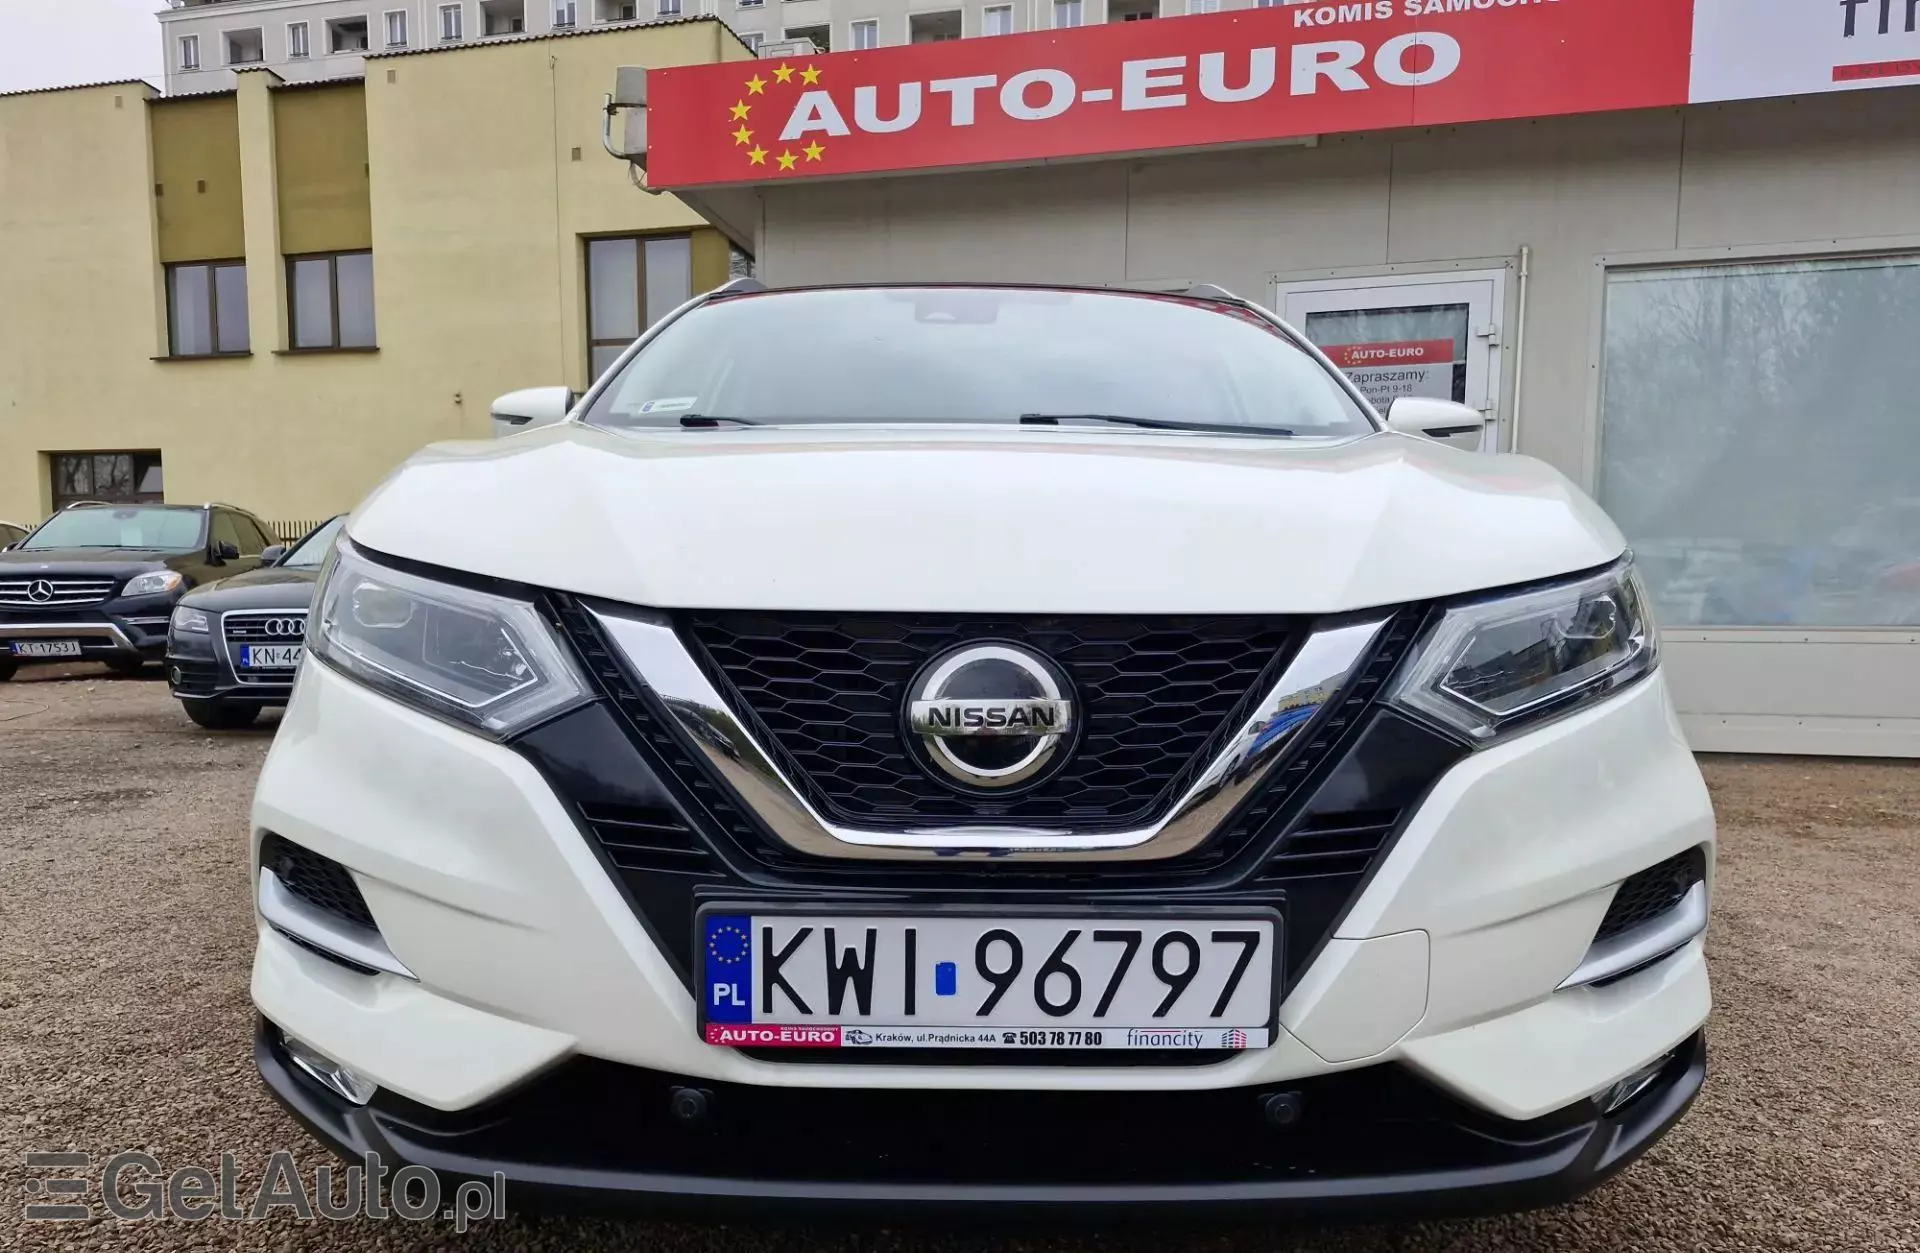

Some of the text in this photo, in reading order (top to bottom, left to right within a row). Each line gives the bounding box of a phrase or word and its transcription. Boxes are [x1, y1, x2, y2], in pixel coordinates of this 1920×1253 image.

[1293, 0, 1393, 27] KOMIS
[778, 30, 1462, 142] AUTO-EURO
[1351, 347, 1424, 360] AUTO-EURO
[1393, 384, 1413, 393] 9-18
[252, 648, 276, 665] KN
[929, 707, 1055, 727] NISSAN
[762, 926, 1262, 1018] KWI 96797
[713, 983, 746, 1007] PL
[719, 1029, 836, 1042] AUTO-EURO
[875, 1033, 914, 1043] Kraków,
[978, 1034, 996, 1042] 44A
[1019, 1031, 1102, 1046] 503 78 77 80
[1127, 1028, 1203, 1050] financity
